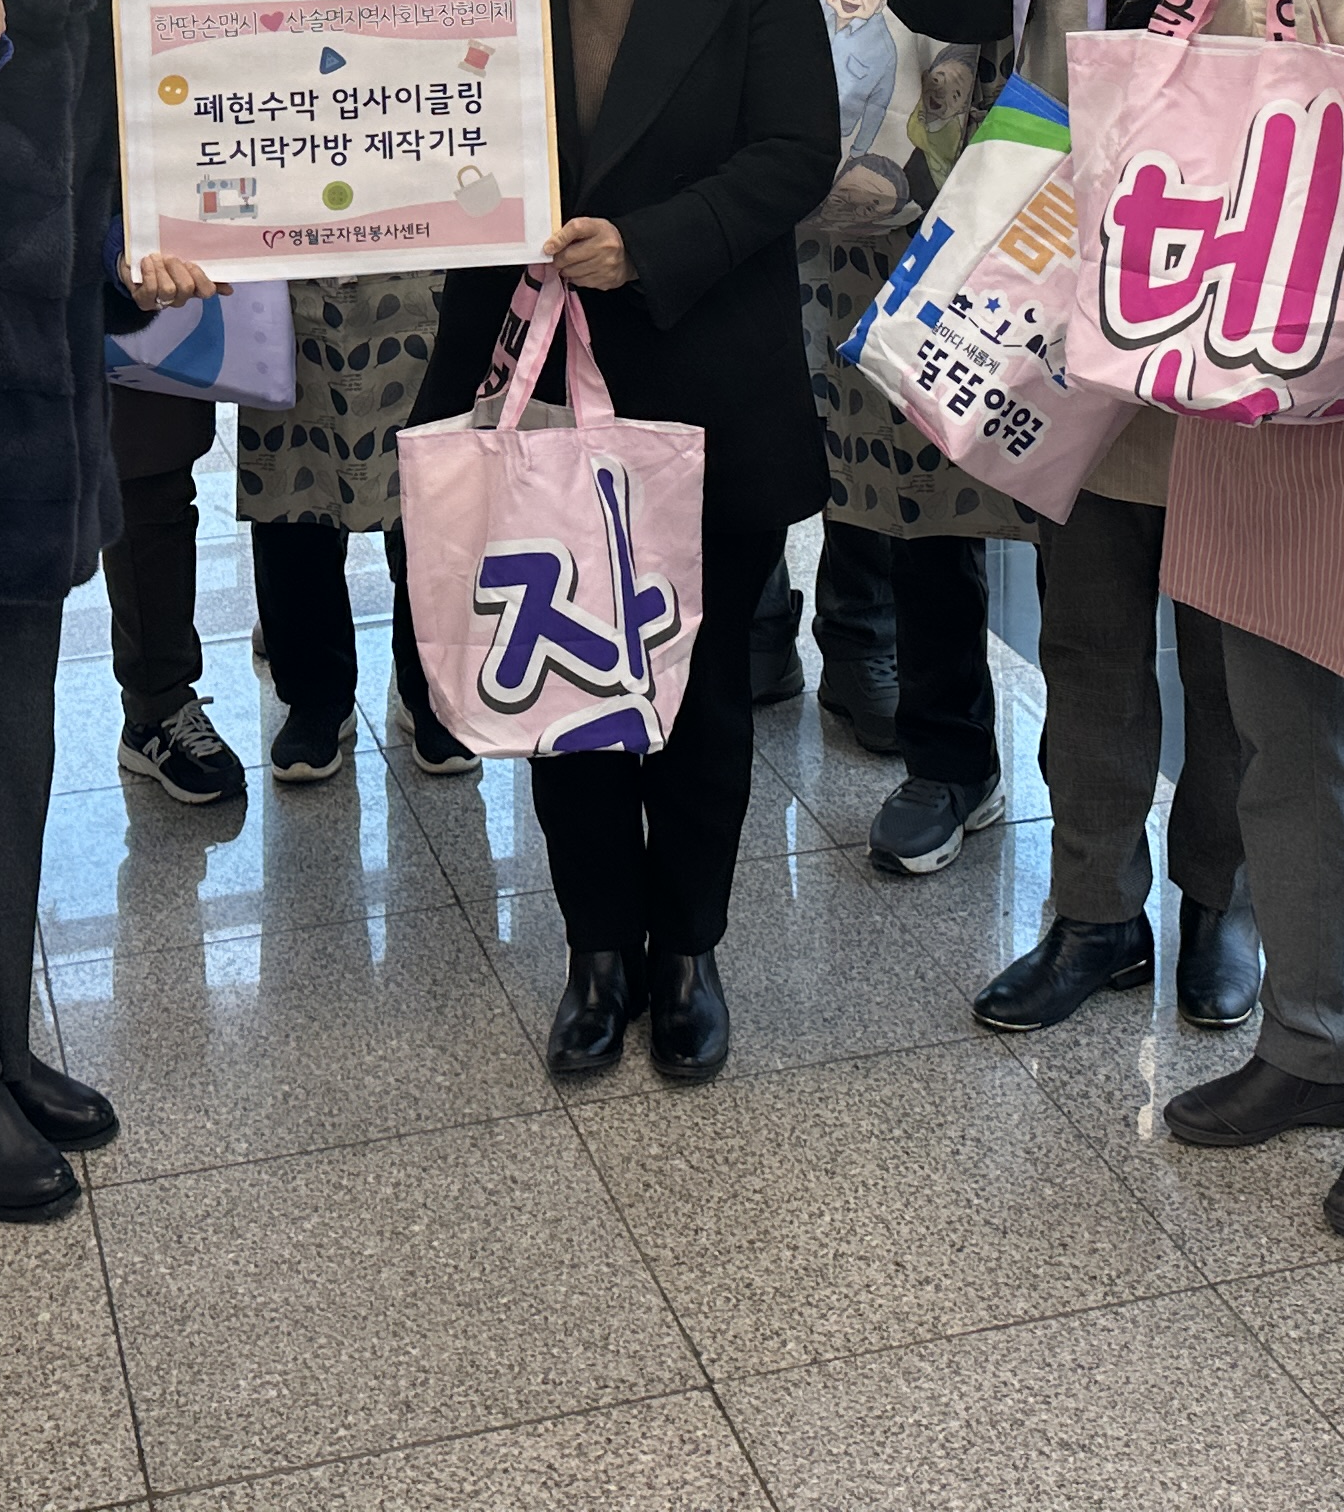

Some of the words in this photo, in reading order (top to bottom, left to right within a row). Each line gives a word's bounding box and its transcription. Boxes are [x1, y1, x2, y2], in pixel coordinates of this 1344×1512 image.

[154, 11, 258, 41] 한땀손맵시
[193, 89, 320, 125] 폐현수막
[331, 81, 484, 120] 업사이클링
[196, 134, 353, 169] 도시락가방
[364, 126, 488, 162] 제작기부
[288, 222, 431, 247] 영월군자원봉사센터
[962, 342, 1002, 376] 새롭게
